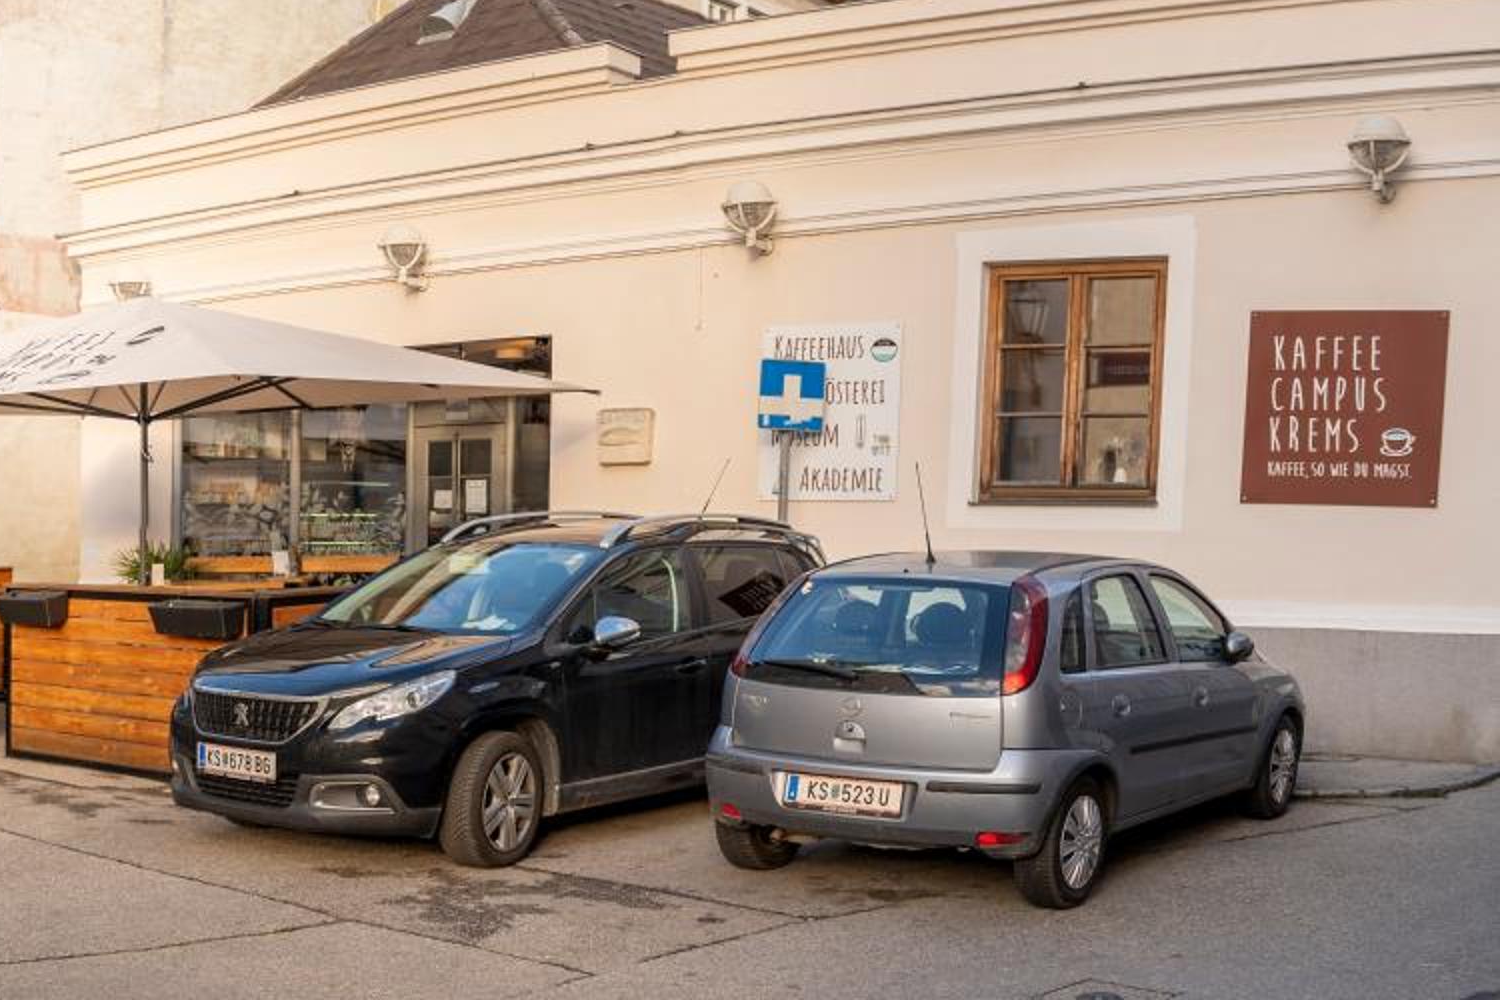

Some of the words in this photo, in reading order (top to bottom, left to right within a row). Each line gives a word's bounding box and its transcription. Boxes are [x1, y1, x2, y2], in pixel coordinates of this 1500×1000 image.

[774, 335, 865, 360] KAFFEEHAUS
[1273, 335, 1381, 371] KAFFEE
[825, 377, 885, 405] ÖSTEREI
[1271, 377, 1386, 412] CAMPUS
[1269, 415, 1359, 453] KREMS
[800, 466, 883, 492] AKADEMIE
[1268, 461, 1309, 478] KAFFEE,
[1311, 462, 1325, 477] SO
[1330, 462, 1348, 477] WIE
[1354, 463, 1368, 477] DU
[807, 780, 829, 800] KS
[841, 784, 874, 804] 523
[879, 788, 891, 806] U
